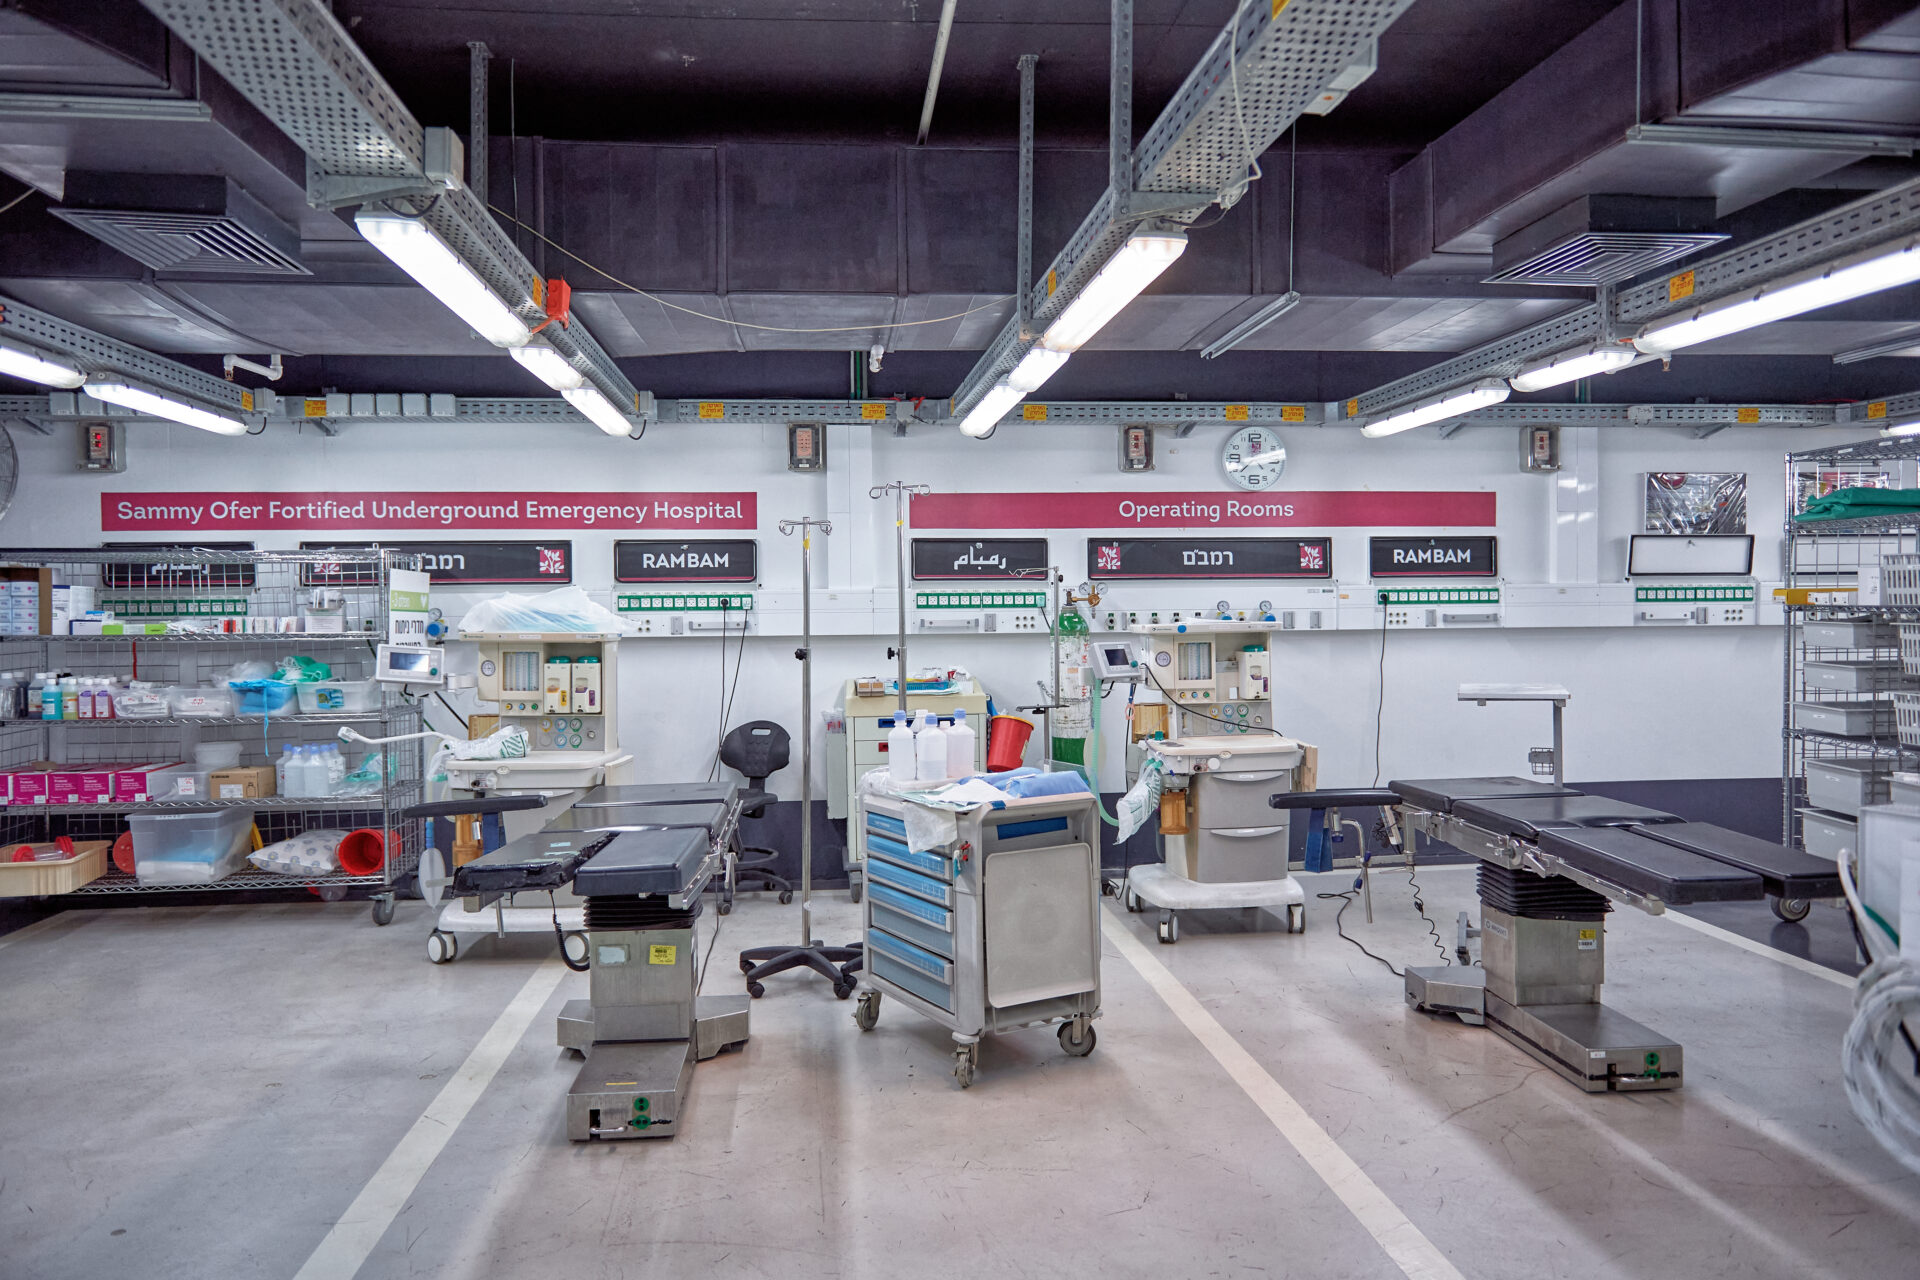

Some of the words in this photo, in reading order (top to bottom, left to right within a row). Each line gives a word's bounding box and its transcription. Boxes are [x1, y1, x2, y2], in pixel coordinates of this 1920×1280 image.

[1248, 433, 1262, 443] 12
[1230, 454, 1240, 464] 9
[1248, 475, 1260, 485] 6
[118, 501, 203, 524] Sammy
[210, 500, 262, 519] Ofer
[269, 500, 365, 519] Fortified
[373, 500, 519, 524] Underground
[526, 501, 648, 524] Emergency
[654, 501, 743, 524] Hospital
[1119, 500, 1220, 523] Operating
[1227, 500, 1294, 517] Rooms
[643, 552, 730, 569] RAMBAM
[953, 545, 1007, 571] رمبام
[1183, 549, 1234, 566] רמב"ם
[1393, 549, 1471, 564] RAMBAM
